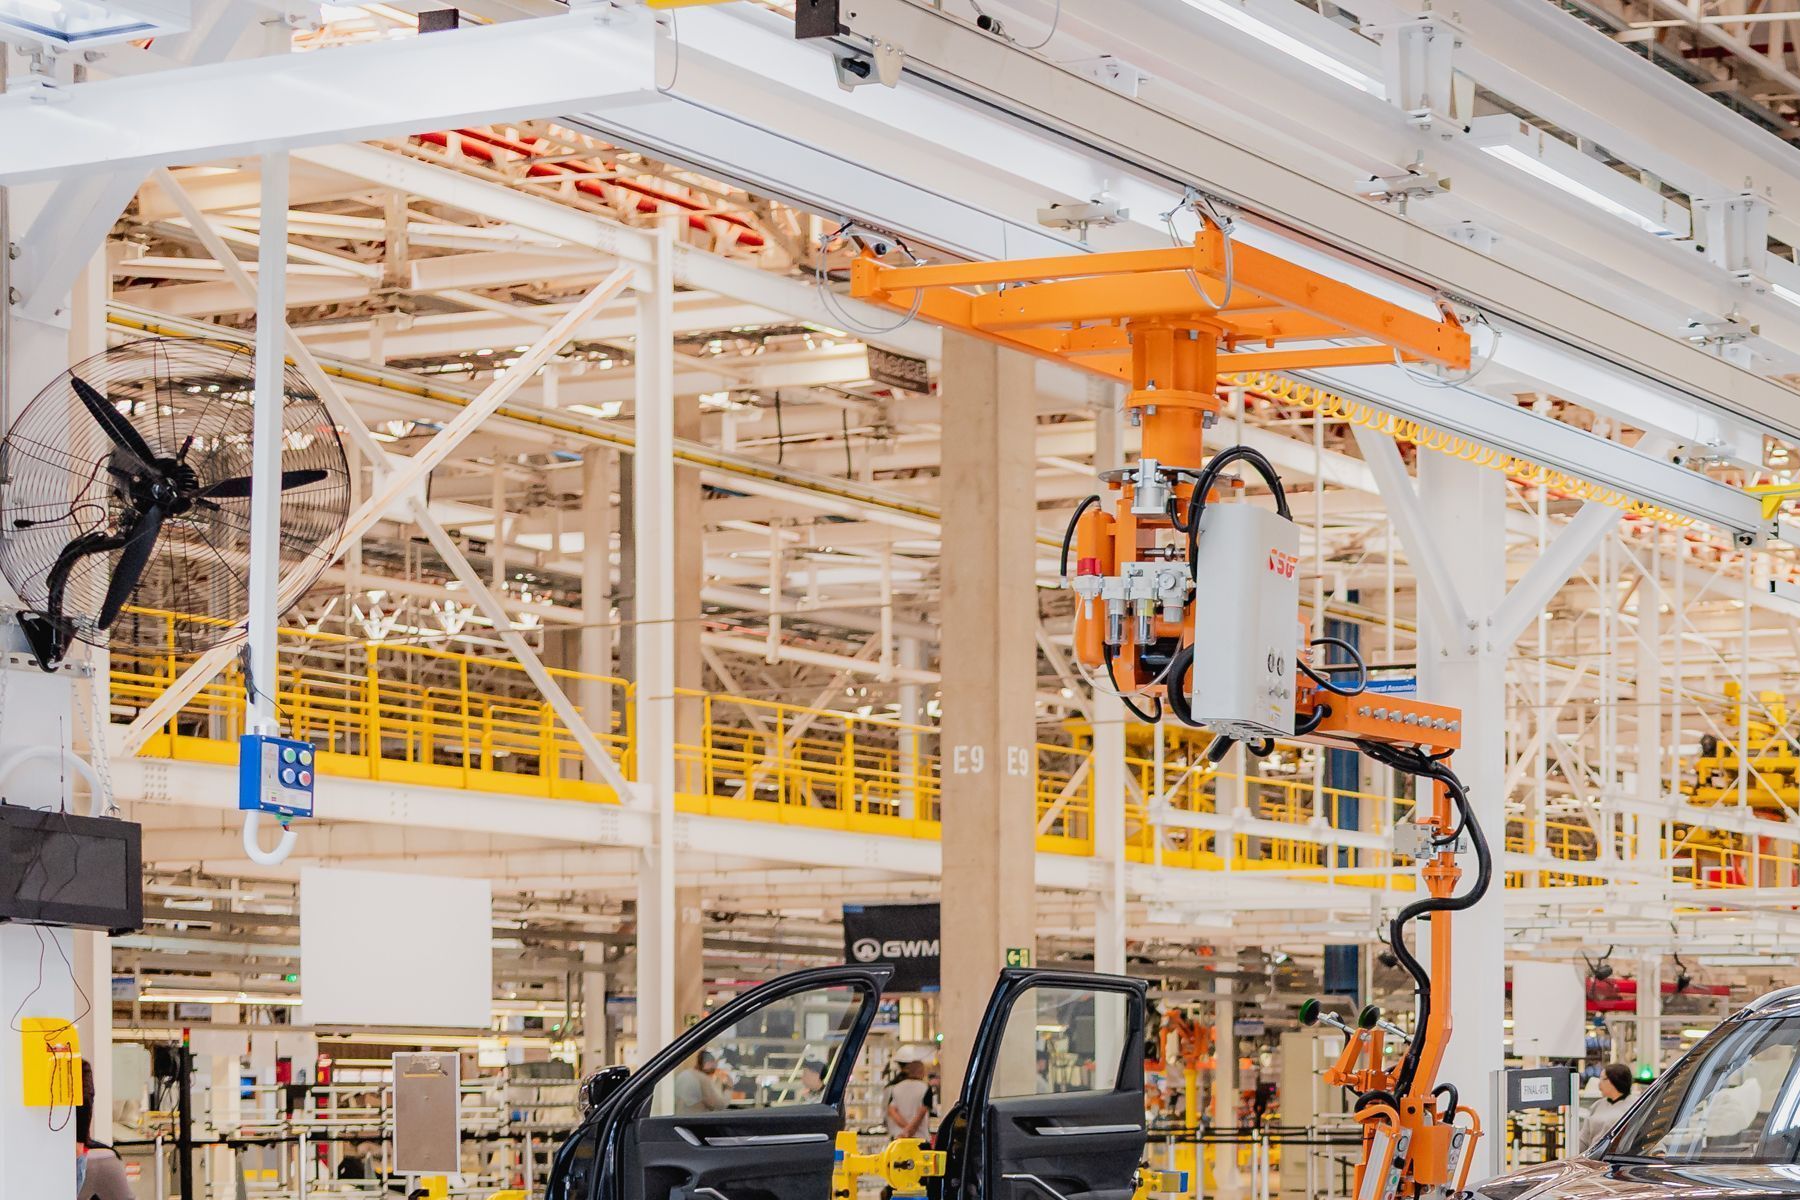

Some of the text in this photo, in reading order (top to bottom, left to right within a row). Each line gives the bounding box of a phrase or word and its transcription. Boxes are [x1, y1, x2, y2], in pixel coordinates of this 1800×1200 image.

[953, 745, 984, 774] E9
[1007, 746, 1029, 776] E9
[882, 940, 940, 958] GWM
